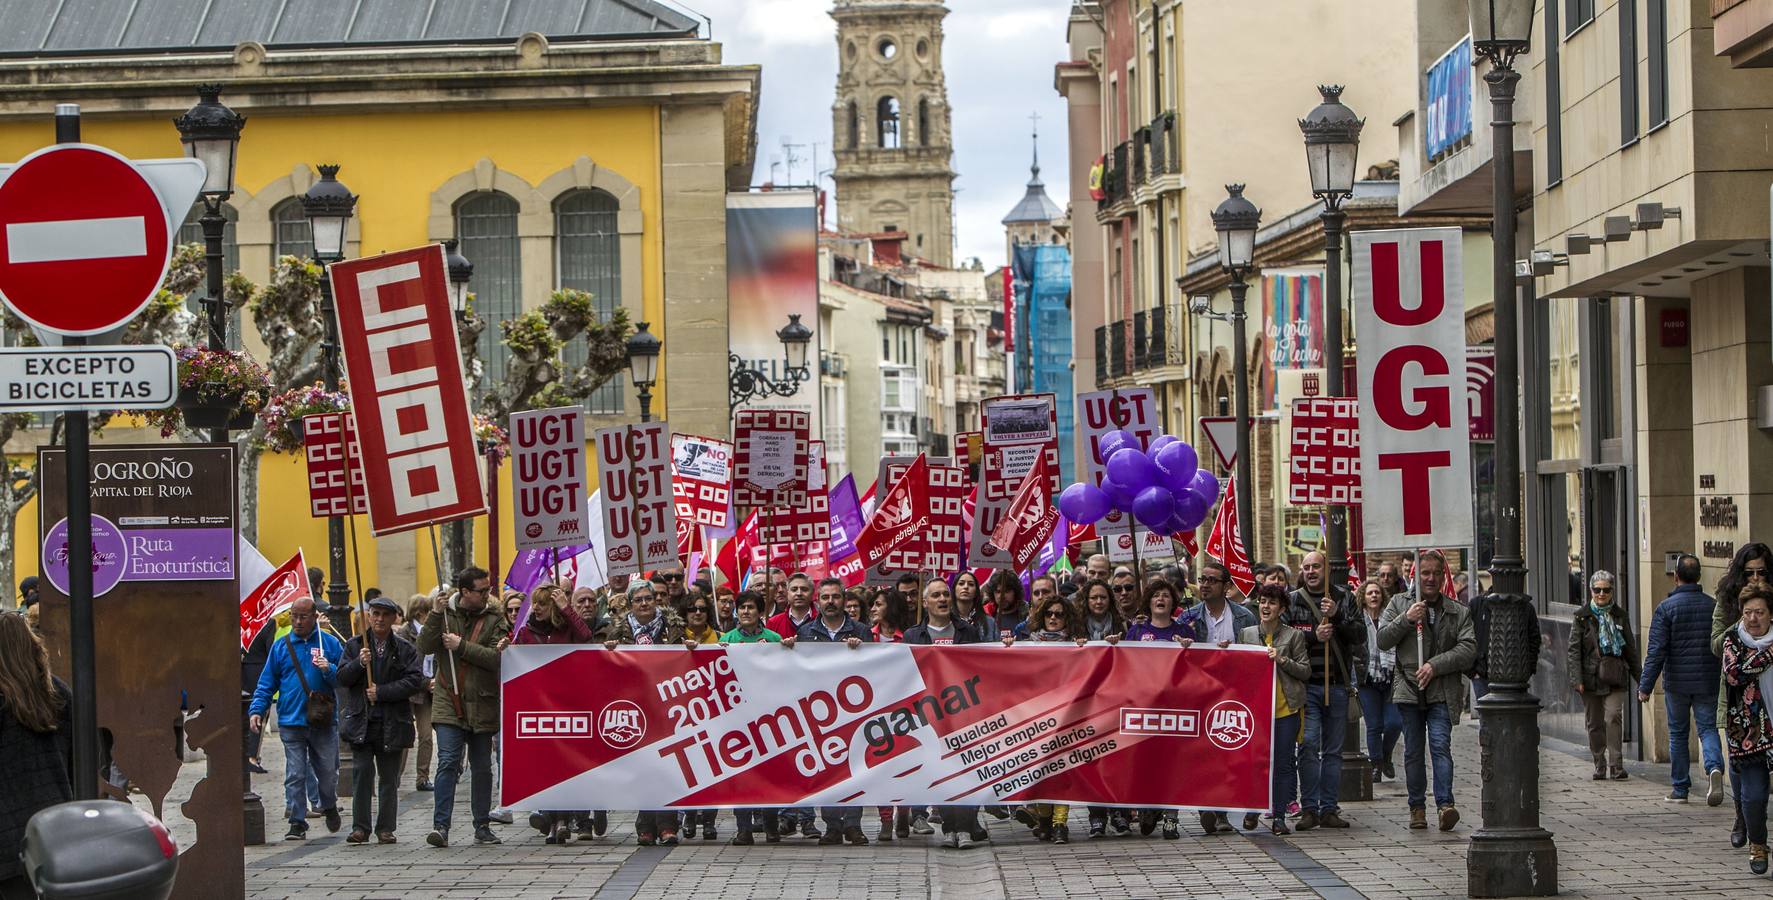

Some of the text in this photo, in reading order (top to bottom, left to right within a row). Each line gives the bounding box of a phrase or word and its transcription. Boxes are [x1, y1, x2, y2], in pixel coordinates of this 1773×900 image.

[1265, 316, 1312, 349] la gota
[1270, 340, 1321, 363] de leche
[25, 357, 135, 376] EXCEPTO
[9, 381, 151, 400] BICICLETAS
[356, 261, 459, 516] CCOO
[1371, 240, 1451, 536] UGT
[737, 412, 808, 429] CCOO
[1085, 394, 1147, 430] UGT
[305, 415, 354, 435] CCO
[517, 413, 577, 448] UGT
[308, 442, 359, 462] CCO
[603, 428, 662, 464] UGT
[706, 448, 726, 460] NO
[1090, 430, 1152, 466] UT
[90, 457, 193, 484] OGROÑO
[518, 448, 579, 483] UGT
[890, 467, 962, 487] COO
[310, 469, 364, 489] CCO
[606, 464, 665, 502] UGT
[90, 485, 193, 498] APITAL DEL RIOJA
[520, 482, 580, 517] UGT
[682, 482, 729, 504] COO
[313, 496, 368, 515] CCO
[930, 496, 961, 514] OO
[609, 501, 667, 539] UGT
[697, 508, 726, 527] OO
[759, 522, 830, 544] CCOO
[131, 536, 173, 556] Ruta
[131, 556, 231, 574] Enoturística
[656, 655, 735, 702] mayo
[604, 709, 640, 727] UGT
[667, 680, 747, 734] 2018
[1213, 709, 1248, 728] UGT
[521, 716, 587, 733] CCOO
[658, 675, 874, 789] Tiempo
[794, 673, 982, 778] de ganar
[944, 714, 1008, 751] Igualdad
[1125, 713, 1195, 732] CCOO
[960, 716, 1058, 766] Mejor empleo
[976, 722, 1096, 783] Mayores salarios
[993, 738, 1118, 798] Pensiones dignas
